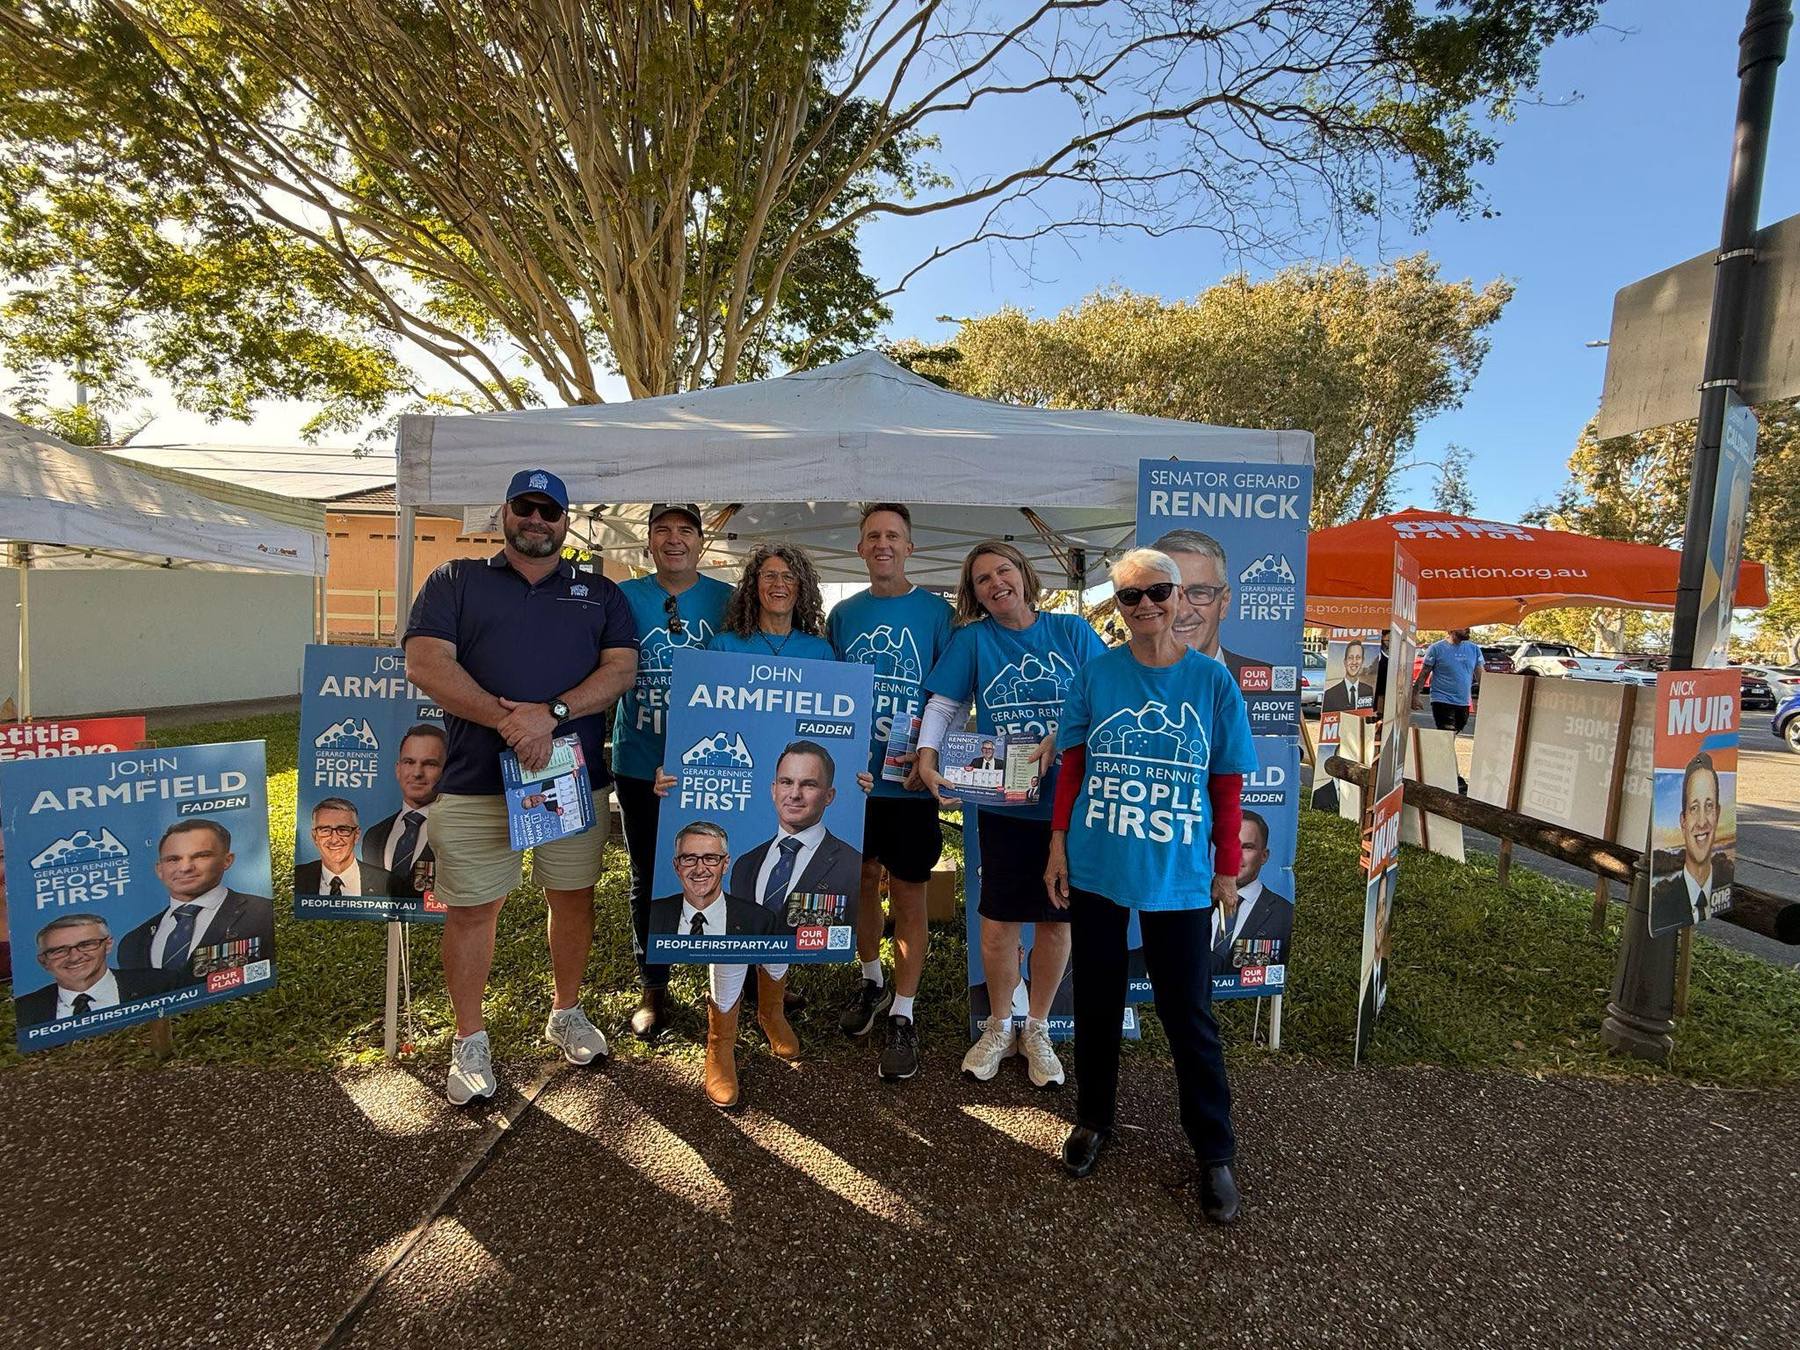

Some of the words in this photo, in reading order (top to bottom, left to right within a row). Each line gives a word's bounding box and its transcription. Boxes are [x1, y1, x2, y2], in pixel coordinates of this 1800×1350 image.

[1151, 471, 1228, 487] SENATOR
[1234, 473, 1300, 489] GERARD
[1150, 491, 1300, 520] RENNICK
[1393, 522, 1525, 534] one
[1398, 532, 1535, 542] NATION
[1419, 565, 1588, 579] enation.org.au
[1241, 593, 1295, 605] PEOPLE
[1240, 605, 1295, 620] FIRST
[748, 665, 802, 684] JOHN
[874, 681, 920, 698] RENNICK
[1669, 680, 1696, 697] NICK
[687, 684, 855, 717] ARMFIELD
[876, 695, 920, 718] PLE
[1252, 701, 1295, 711] ABOVE
[991, 709, 1034, 722] GERARD
[1667, 695, 1734, 736] MUIR
[798, 723, 852, 736] FADDEN
[346, 751, 379, 759] RENNICK
[108, 756, 178, 781] JOHN
[316, 758, 378, 772] PEOPLE
[682, 768, 715, 776] GERARD
[717, 769, 753, 778] RENNICK
[1096, 760, 1140, 776] ERARD
[314, 771, 378, 789] FIRST
[682, 777, 752, 793] PEOPLE
[28, 771, 247, 815] ARMFIELD
[680, 791, 752, 811] FIRST
[1087, 776, 1202, 812] PEOPLE
[181, 797, 247, 814] FADDEN
[1085, 798, 1203, 845] FIRST
[33, 865, 80, 879] GERARD
[81, 858, 130, 872] RENNICK
[35, 865, 131, 892] PEOPLE
[36, 879, 131, 910] FIRST
[1711, 887, 1731, 907] one
[301, 899, 417, 911] PEOPLEFIRSTPARTY.AU
[801, 930, 822, 938] OUR
[656, 939, 789, 950] PEOPLEFIRSTPARTY.AU
[799, 938, 824, 947] PLAN
[210, 976, 242, 991] PLAN
[212, 970, 238, 983] OUR
[1242, 976, 1263, 984] PLAN
[28, 989, 199, 1039] PEOPLEFIRSTPARTY.AU
